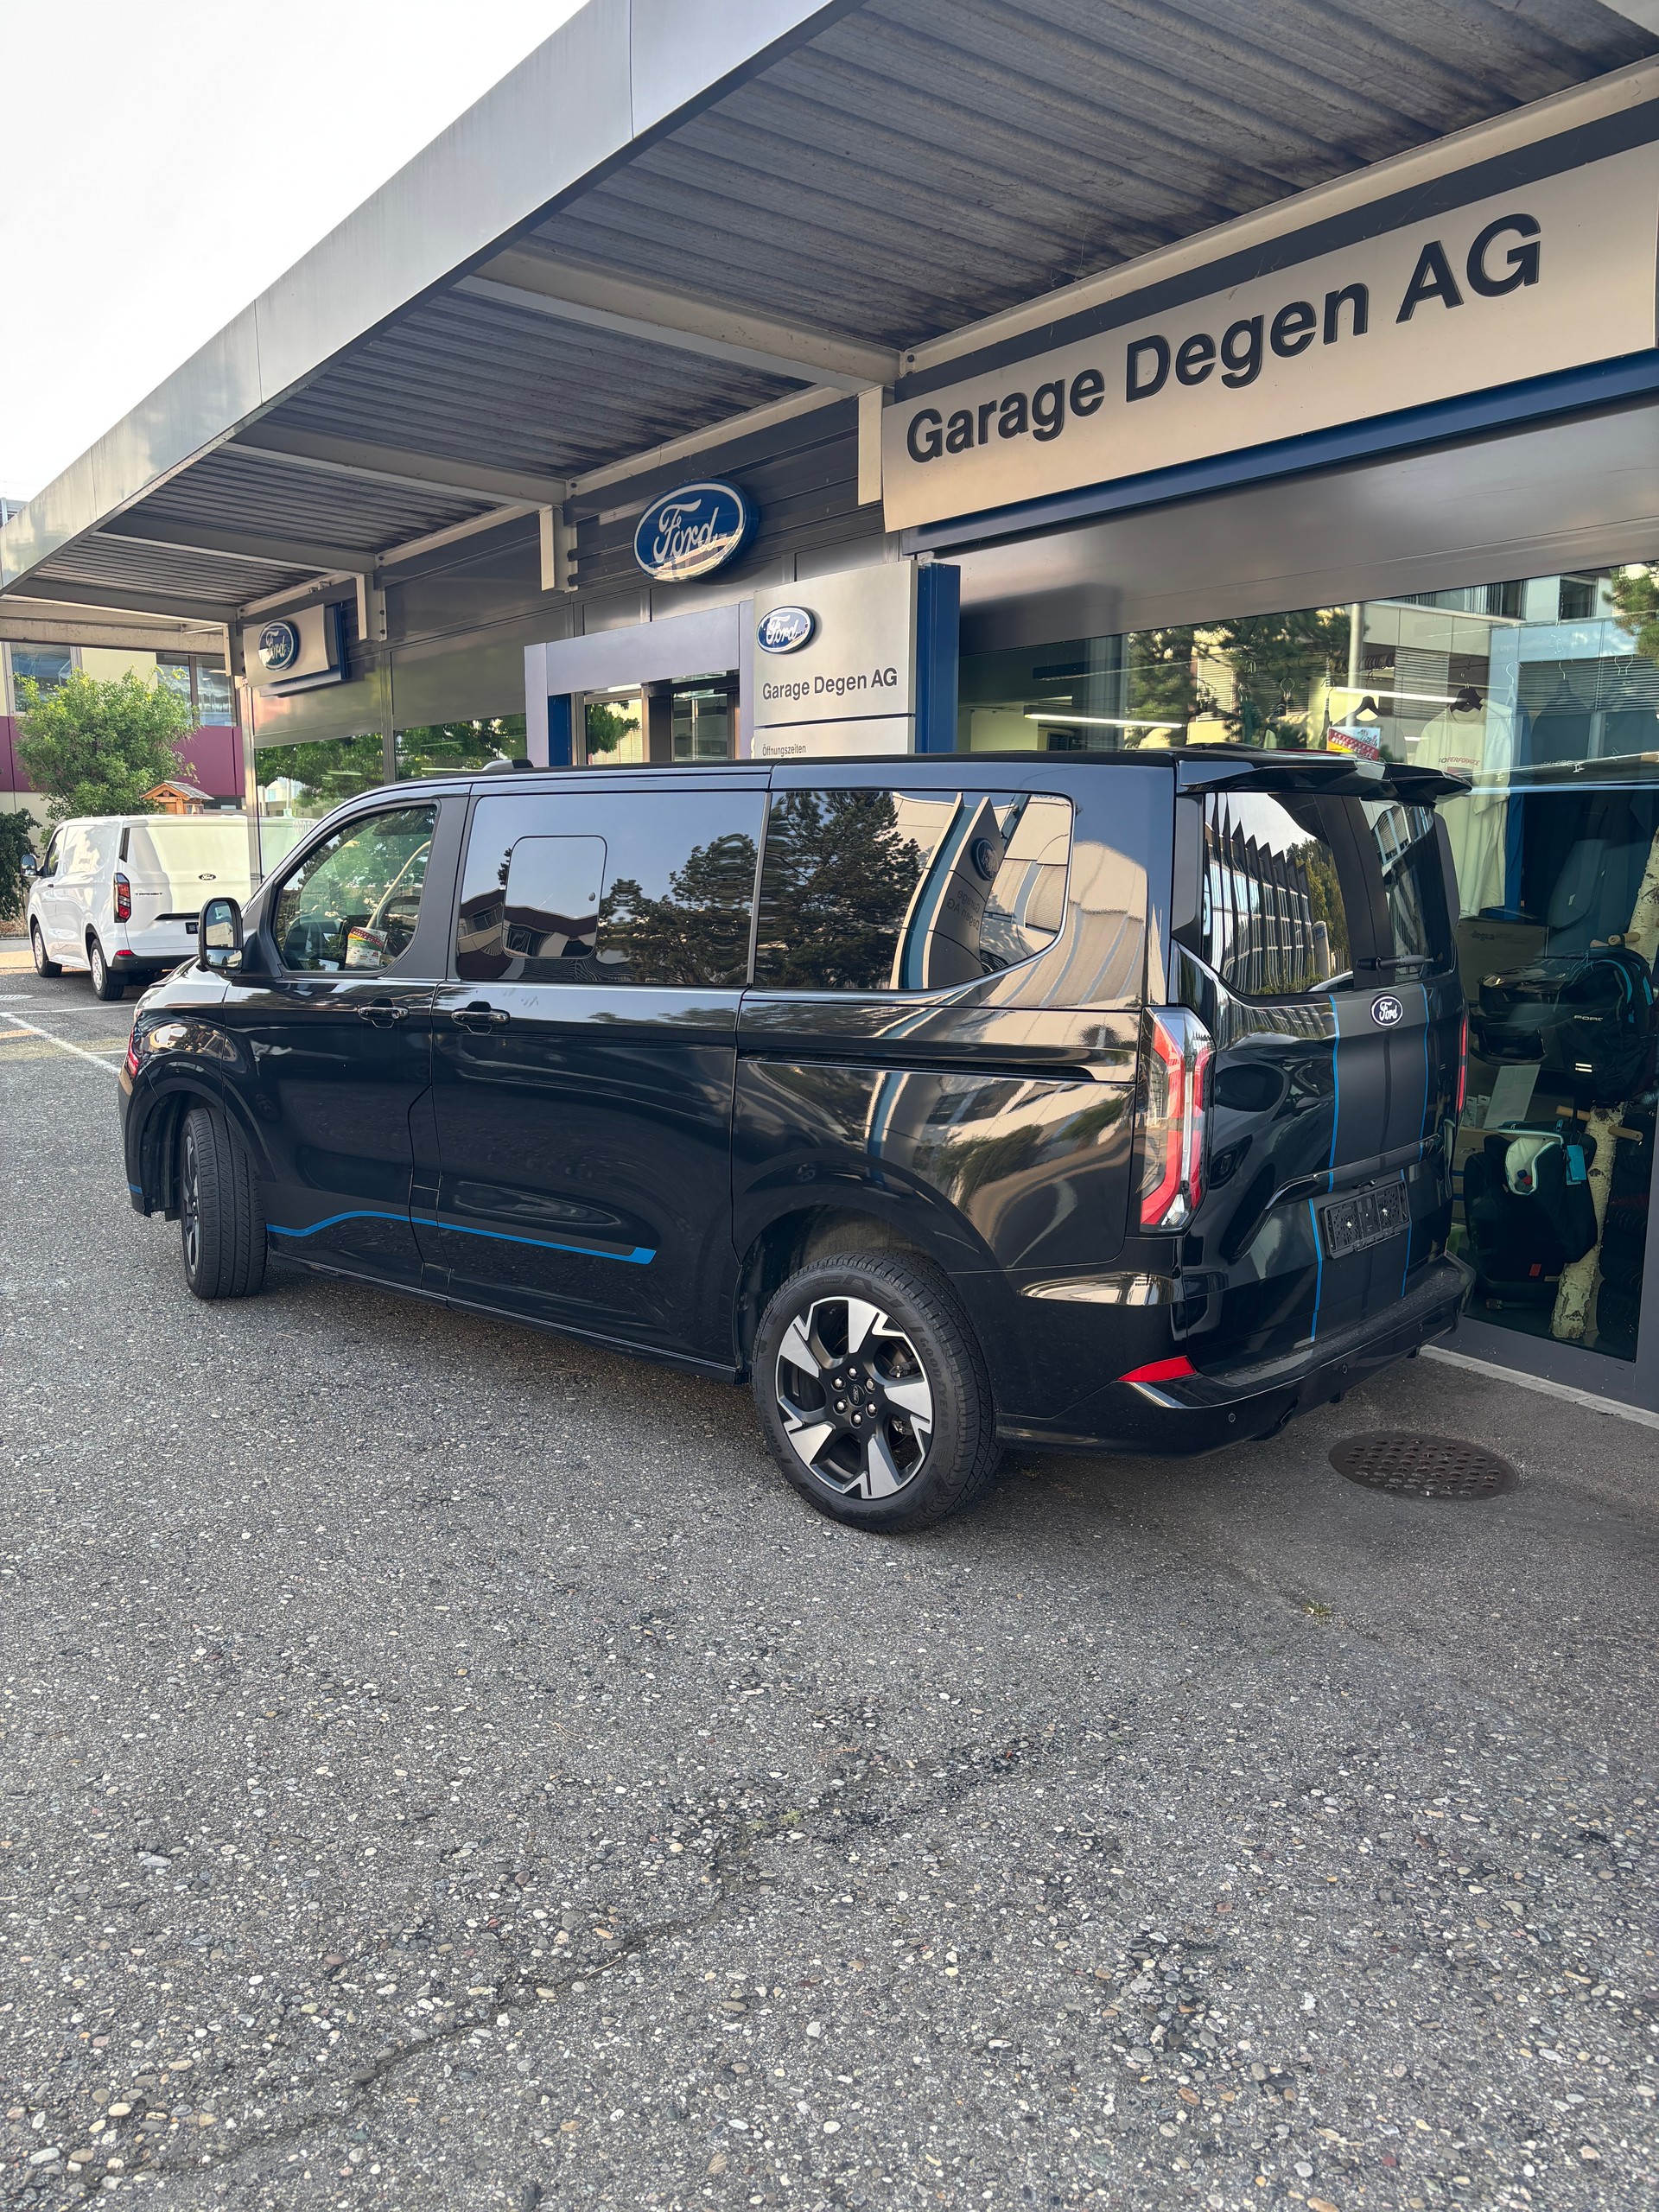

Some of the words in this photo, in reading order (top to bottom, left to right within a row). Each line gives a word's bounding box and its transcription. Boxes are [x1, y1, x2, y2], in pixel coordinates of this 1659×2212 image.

[907, 369, 1105, 463] Garage
[1126, 282, 1369, 404] Degen
[1395, 213, 1541, 324] AG
[653, 499, 719, 563] Ford
[264, 630, 286, 659] Ford
[766, 614, 800, 645] Ford
[762, 680, 810, 701] Garage
[814, 675, 867, 696] Degen
[871, 667, 897, 688] AG
[762, 744, 806, 757] Öffnungszeiten
[1379, 1001, 1398, 1020] Ford
